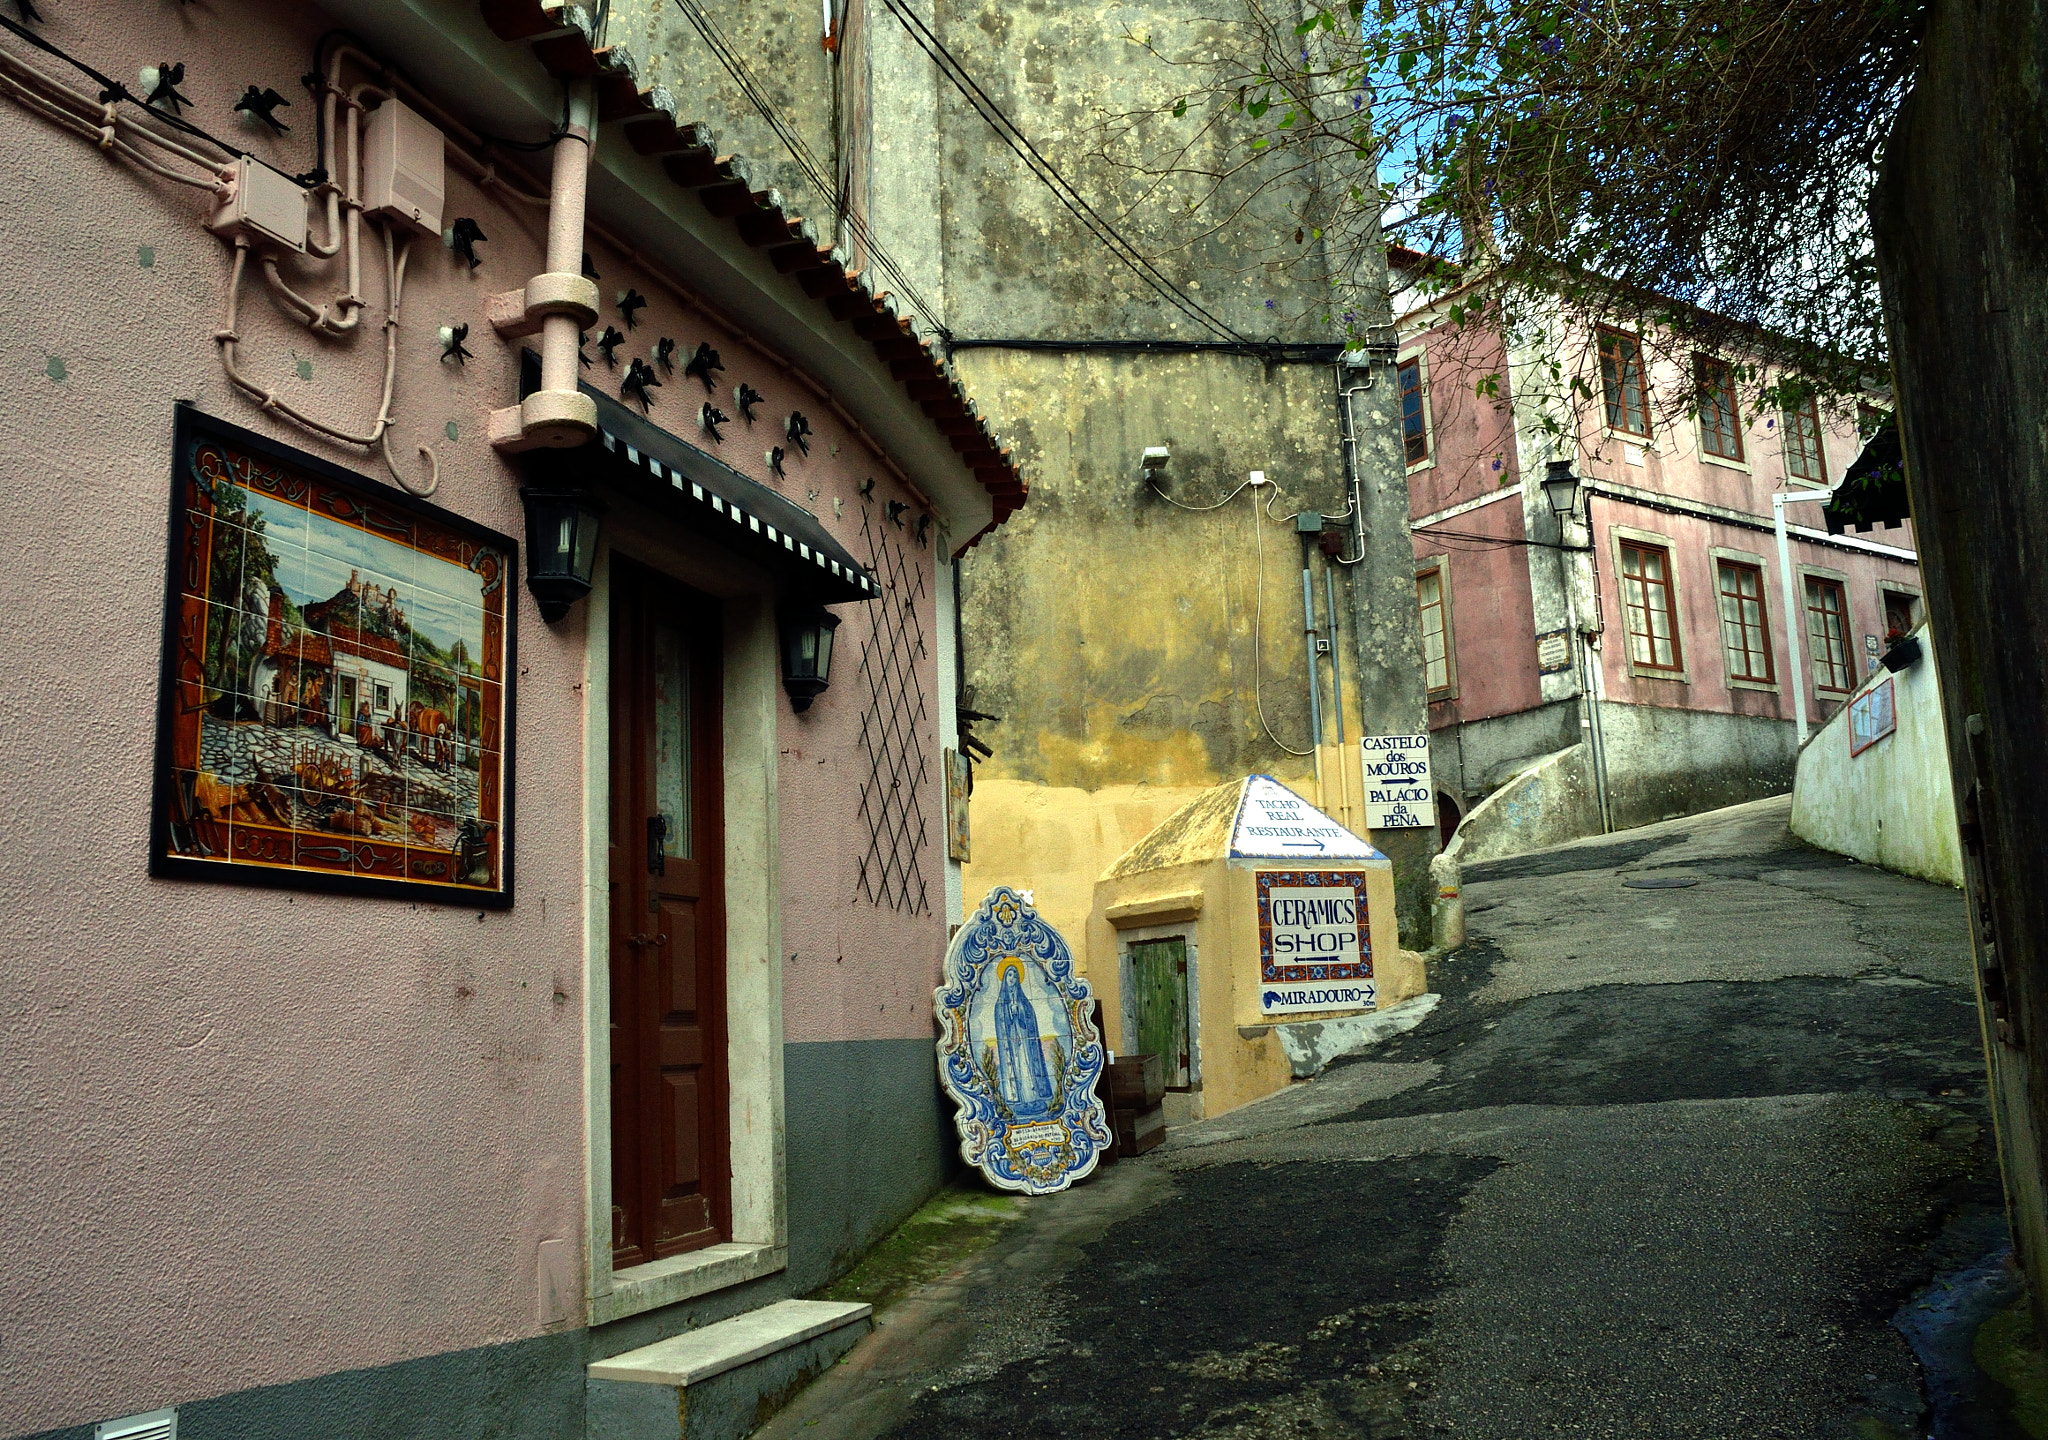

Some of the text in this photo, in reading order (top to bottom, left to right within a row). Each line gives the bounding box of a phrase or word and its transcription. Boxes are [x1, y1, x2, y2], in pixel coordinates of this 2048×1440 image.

[1363, 736, 1427, 750] CASTELO
[1386, 750, 1406, 762] dos
[1367, 762, 1427, 776] MOUROS
[1370, 787, 1428, 802] PALÁCIO
[1255, 799, 1300, 809] TACHO
[1393, 803, 1408, 815] da
[1265, 811, 1304, 821] REAL
[1382, 814, 1421, 827] PENA
[1246, 826, 1343, 838] RESTAURANTE
[1272, 898, 1356, 930] CERAMICS
[1274, 932, 1356, 953] SHOP
[1280, 988, 1362, 1006] MIRADOURO
